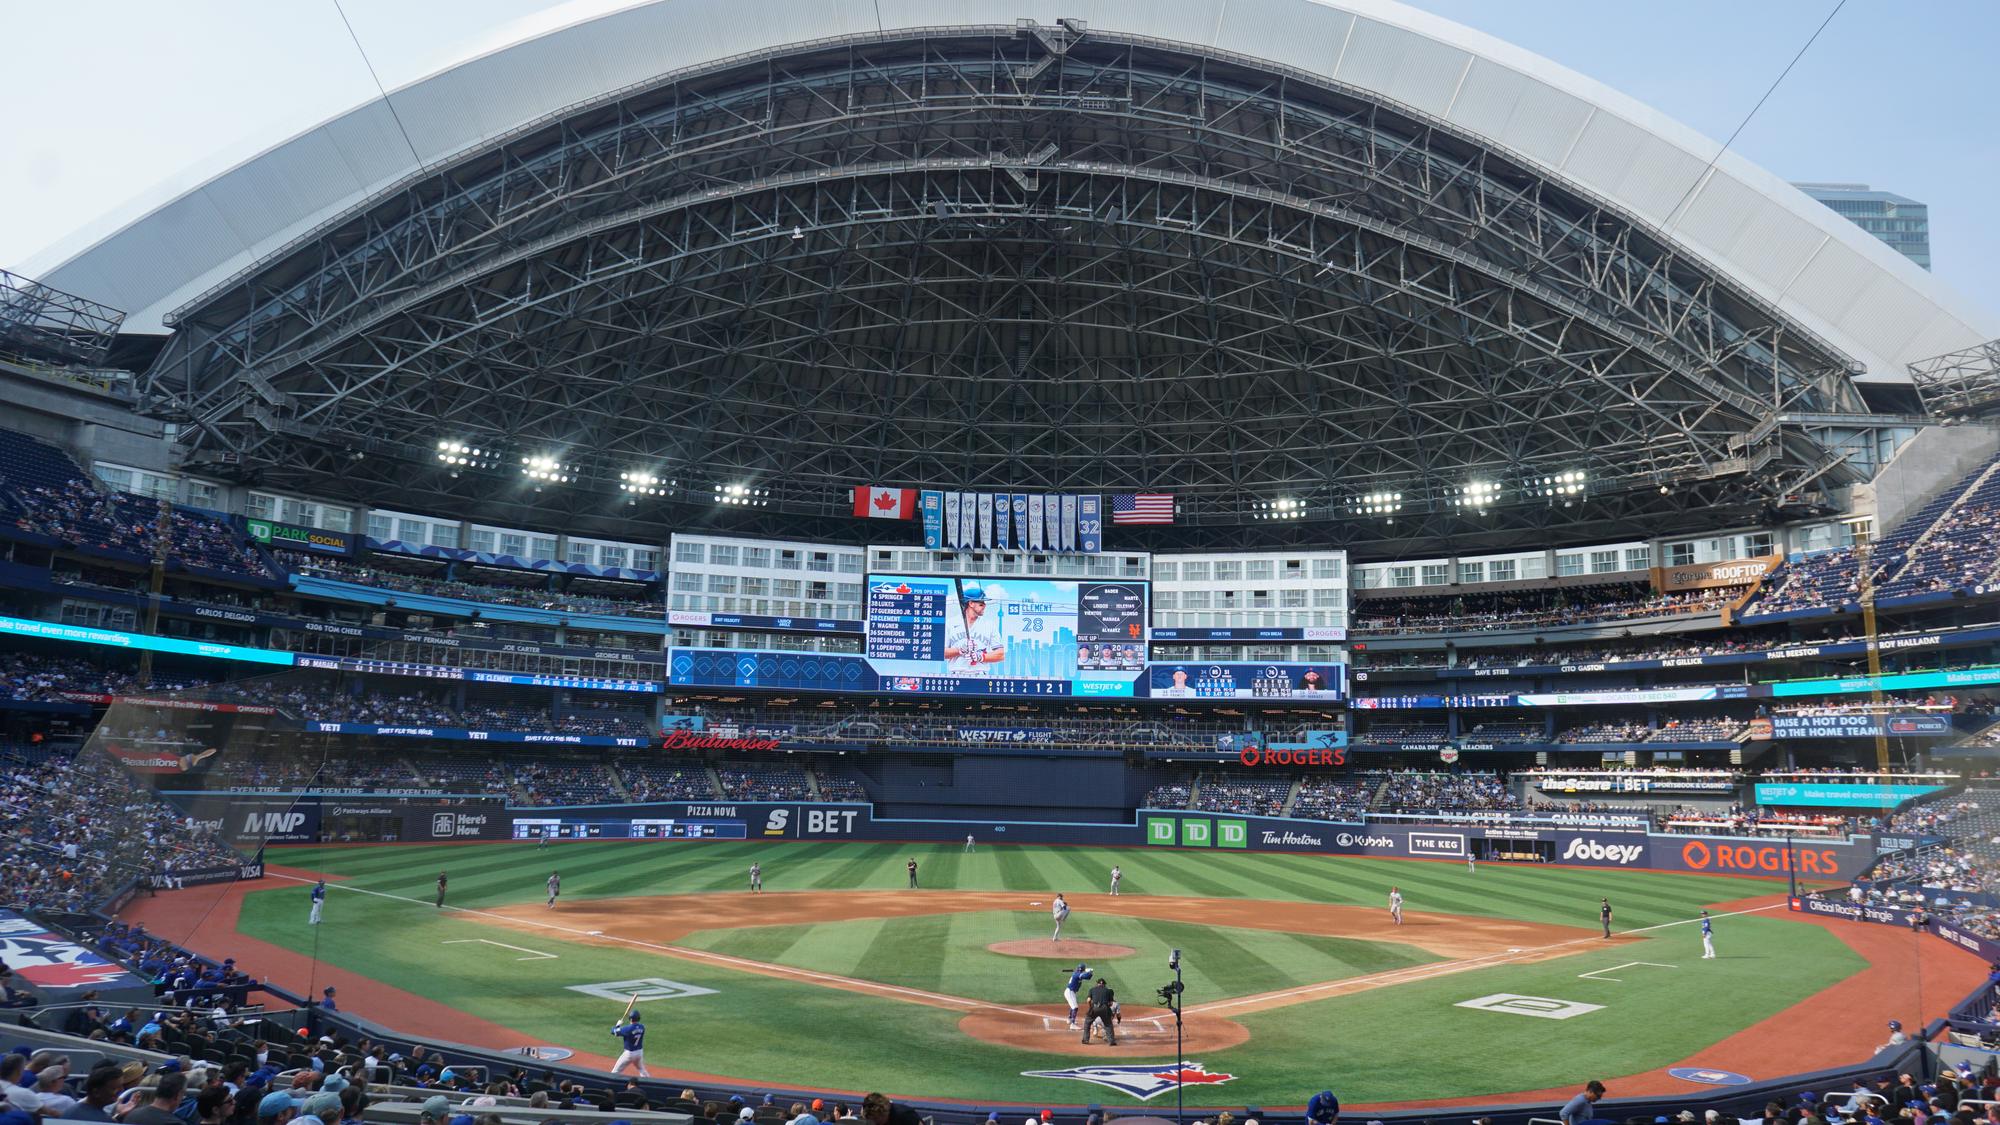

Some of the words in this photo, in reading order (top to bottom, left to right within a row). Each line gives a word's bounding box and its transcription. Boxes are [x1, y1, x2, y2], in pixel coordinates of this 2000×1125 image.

[250, 524, 270, 541] TD
[1080, 520, 1100, 534] 32
[272, 526, 309, 542] PARK
[309, 534, 346, 548] SOCIAL
[1713, 564, 1767, 579] ROOFTOP
[196, 607, 220, 619] CARLOS
[222, 610, 256, 622] DELGADO
[16, 622, 40, 632] travel
[42, 626, 62, 634] even
[64, 629, 87, 638] more
[305, 623, 323, 632] 4306
[324, 625, 340, 634] TOM
[341, 627, 362, 636] CHEEK
[1022, 618, 1043, 632] 28
[404, 634, 422, 643] TONY
[423, 636, 460, 646] FERNANDEZ
[1879, 641, 1896, 649] ROY
[1900, 636, 1940, 647] HALLADAY
[1786, 648, 1820, 657] BEESTON
[1676, 658, 1702, 666] GILLICK
[486, 674, 512, 683] CLEMENT
[1947, 672, 1971, 682] Make
[1047, 684, 1052, 693] 2
[320, 723, 340, 732] YETI
[1775, 718, 1799, 727] RAISE
[1802, 718, 1810, 726] A
[1814, 717, 1836, 726] HOT
[1842, 716, 1867, 726] DOG
[468, 732, 488, 740] YETI
[959, 730, 1012, 741] WESTJET
[1775, 728, 1786, 737] TO
[1788, 728, 1806, 736] THE
[1809, 727, 1842, 736] HOME
[1846, 727, 1883, 736] TEAM!
[660, 729, 780, 750] Budweiser
[1264, 749, 1344, 765] ROGERS
[1542, 778, 1612, 790] theScore
[1624, 778, 1649, 791] BET
[1760, 788, 1787, 797] WESTJET
[687, 806, 712, 816] PIZZA
[714, 806, 736, 817] NOVA
[243, 812, 305, 832] MNP
[457, 814, 487, 824] Here's
[767, 809, 789, 830] S
[808, 810, 858, 833] BET
[1552, 814, 1606, 826] CANADA
[457, 826, 480, 835] How.
[1150, 822, 1172, 840] TD
[1185, 823, 1208, 840] TD
[1220, 824, 1244, 842] TD
[1262, 831, 1281, 844] Tim
[1282, 831, 1322, 846] Hortons
[1354, 836, 1394, 848] Kubota
[1415, 840, 1434, 848] THE
[1438, 840, 1458, 849] KEG
[1880, 837, 1899, 848] FIELD
[1900, 839, 1913, 849] SIDE
[1563, 837, 1643, 864] Sobeys
[1717, 845, 1838, 874] ROGERS
[241, 866, 261, 878] VISA
[1810, 901, 1835, 913] Official
[1865, 909, 1893, 923] Shingle
[634, 1034, 641, 1046] 7
